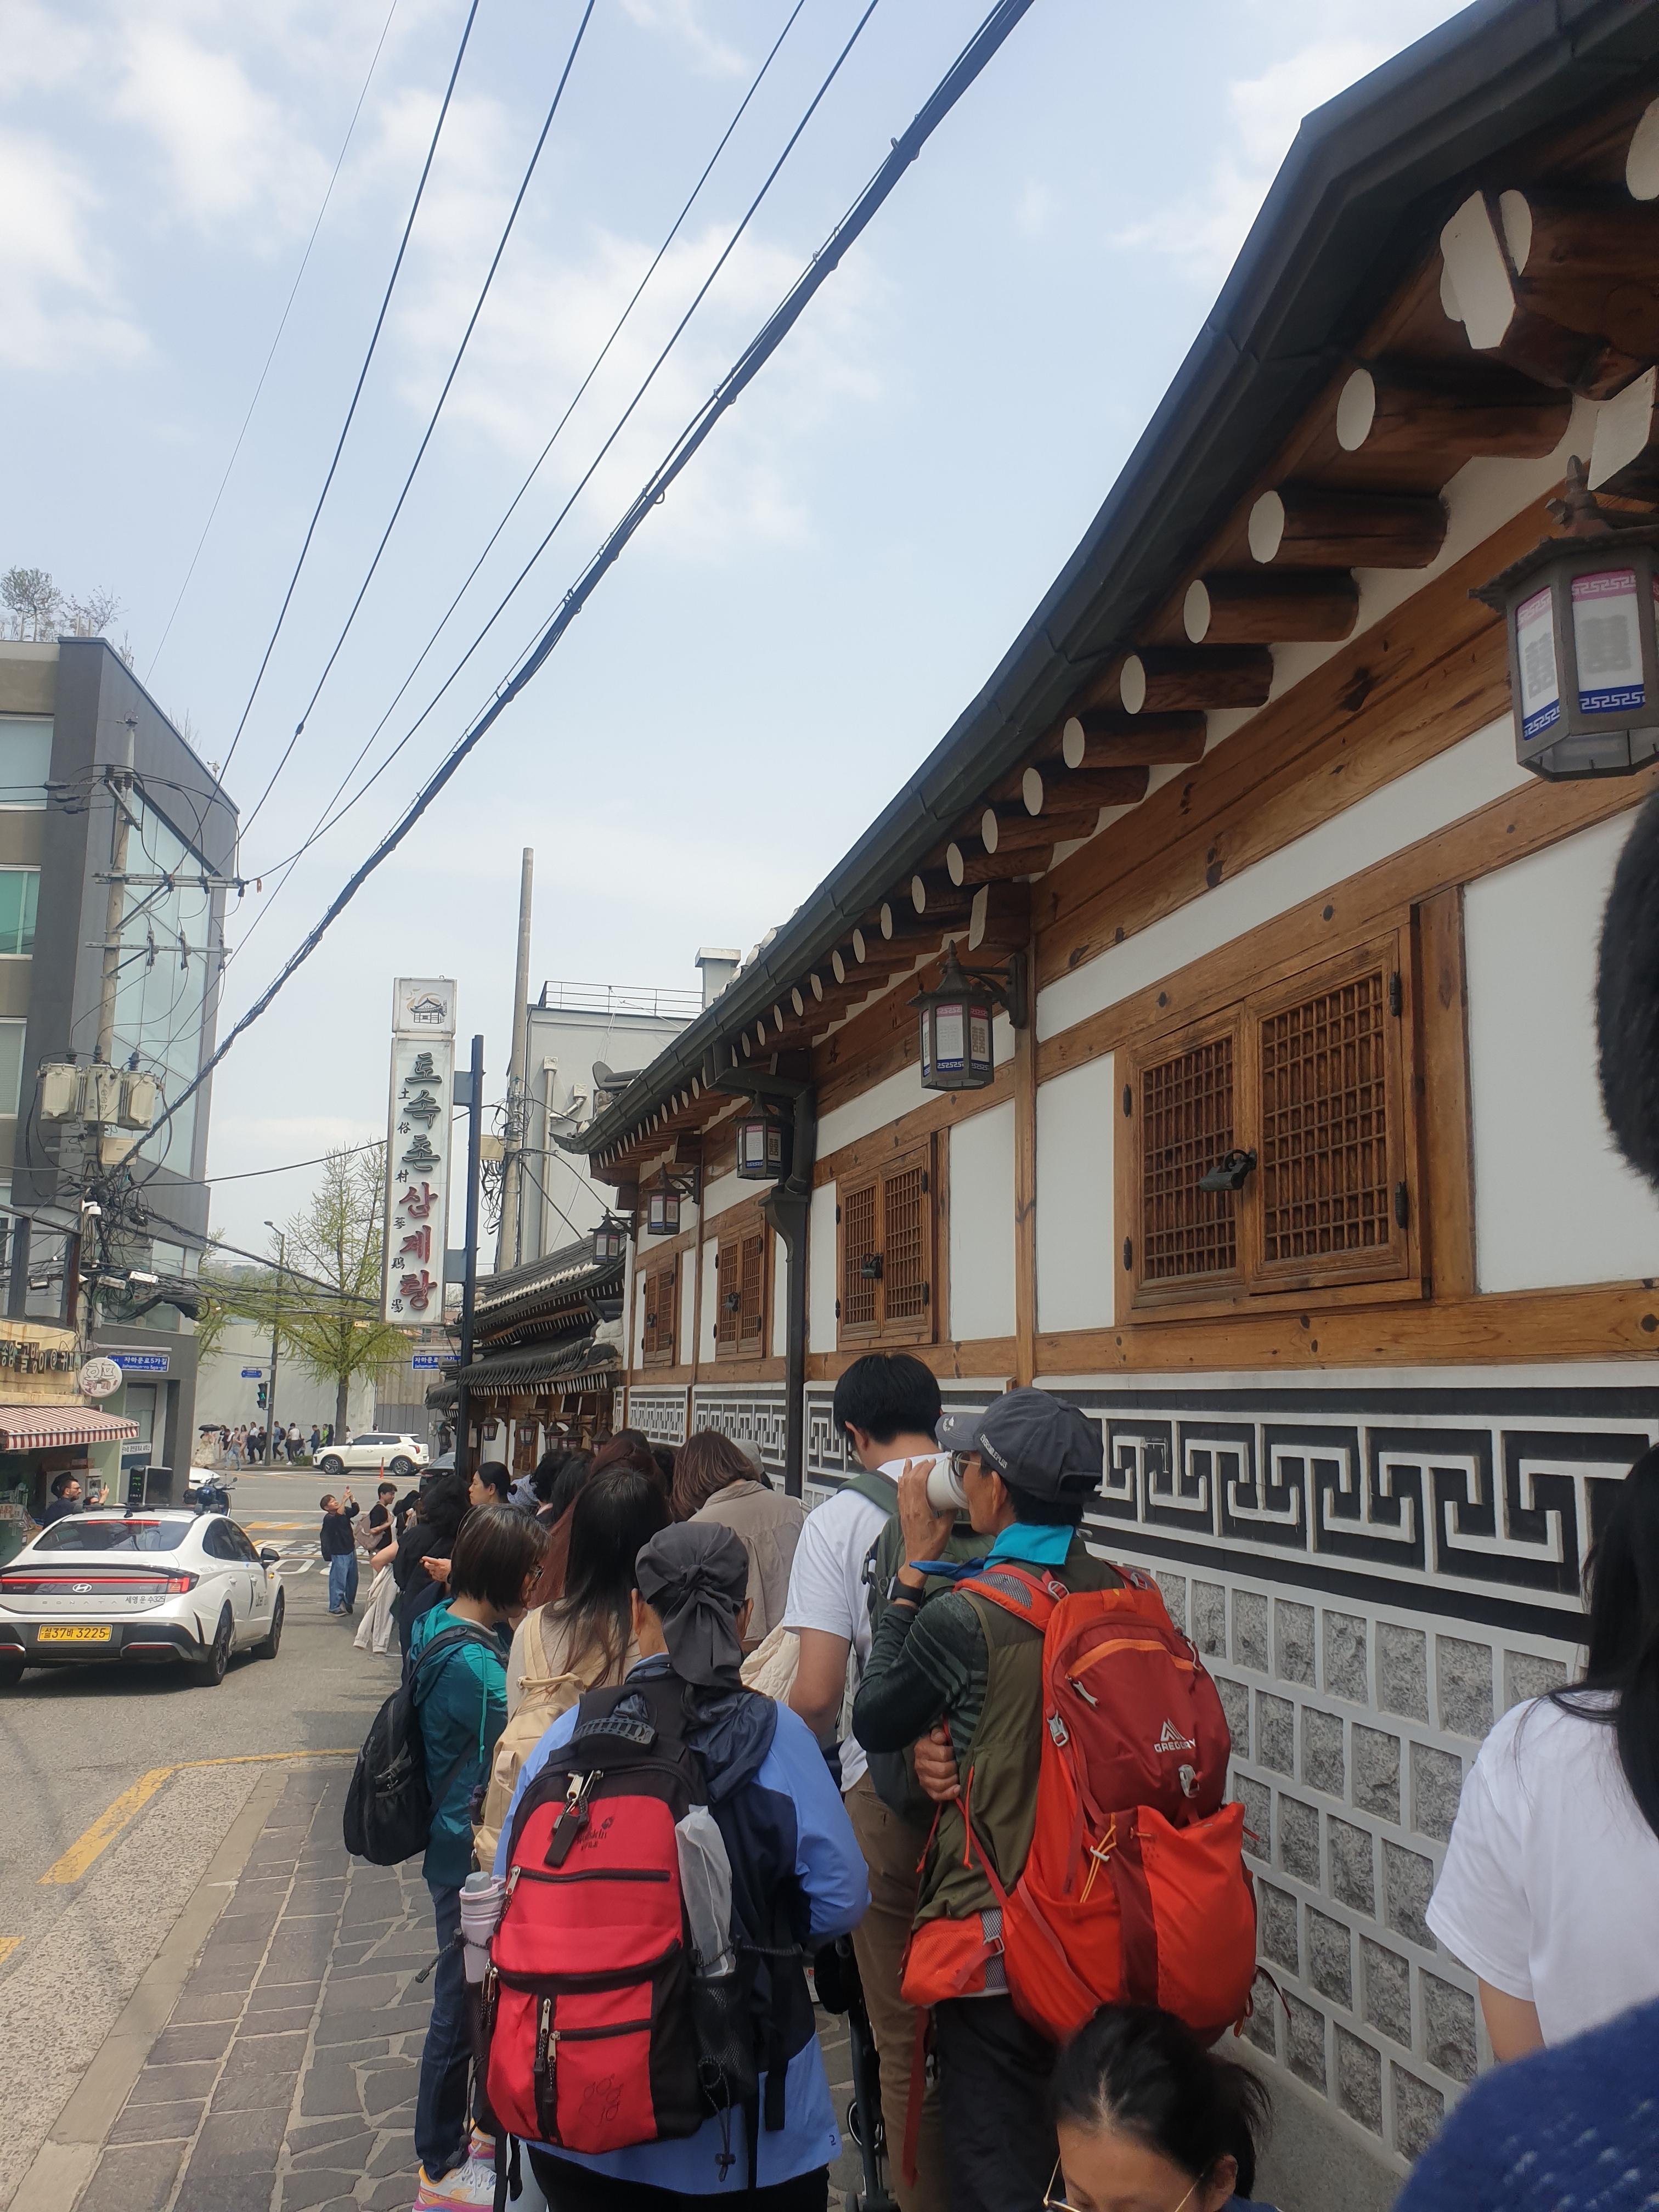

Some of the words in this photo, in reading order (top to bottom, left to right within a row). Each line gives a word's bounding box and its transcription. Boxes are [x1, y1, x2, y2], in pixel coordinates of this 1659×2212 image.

[402, 1052, 443, 1173] 토속촌
[399, 1181, 439, 1311] 삼계탕
[84, 1362, 116, 1381] 호프
[76, 1628, 106, 1639] 3225
[1154, 1738, 1196, 1753] GREGORY
